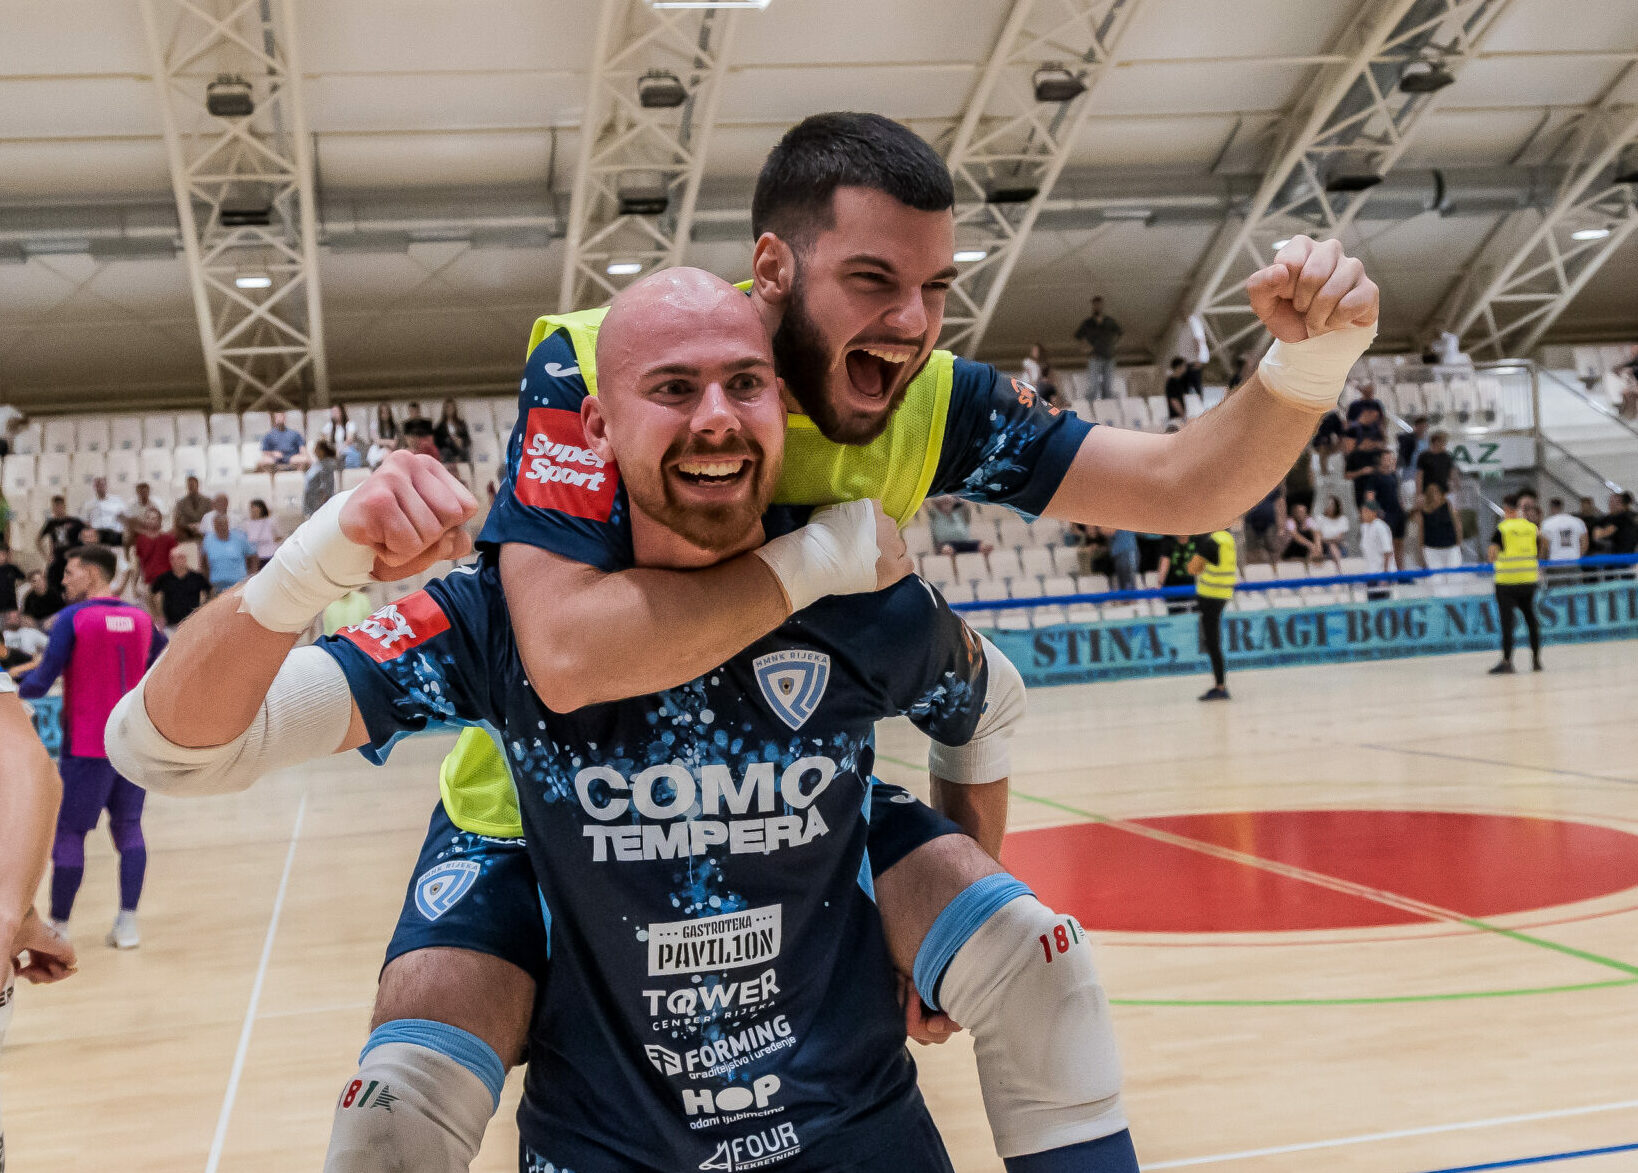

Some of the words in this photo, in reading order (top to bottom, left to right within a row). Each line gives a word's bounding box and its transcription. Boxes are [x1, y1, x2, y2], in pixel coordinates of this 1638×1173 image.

[527, 433, 606, 468] Super
[1451, 442, 1501, 464] AZ
[526, 459, 605, 491] Sport
[1033, 621, 1178, 667] STINA,
[1346, 605, 1428, 643] BOG
[1444, 601, 1518, 637] NA
[755, 652, 785, 668] HMNK
[790, 651, 827, 663] RIJEKA
[574, 755, 836, 821] COMO
[582, 804, 830, 862] TEMPERA
[682, 915, 752, 939] GASTROTEKA
[685, 1014, 792, 1072] FORMING
[681, 1073, 781, 1116] HOP
[689, 1116, 720, 1130] odani
[722, 1105, 785, 1125] ljubimcima
[731, 1121, 800, 1163] FOUR
[735, 1147, 801, 1172] NEKRETNINE
